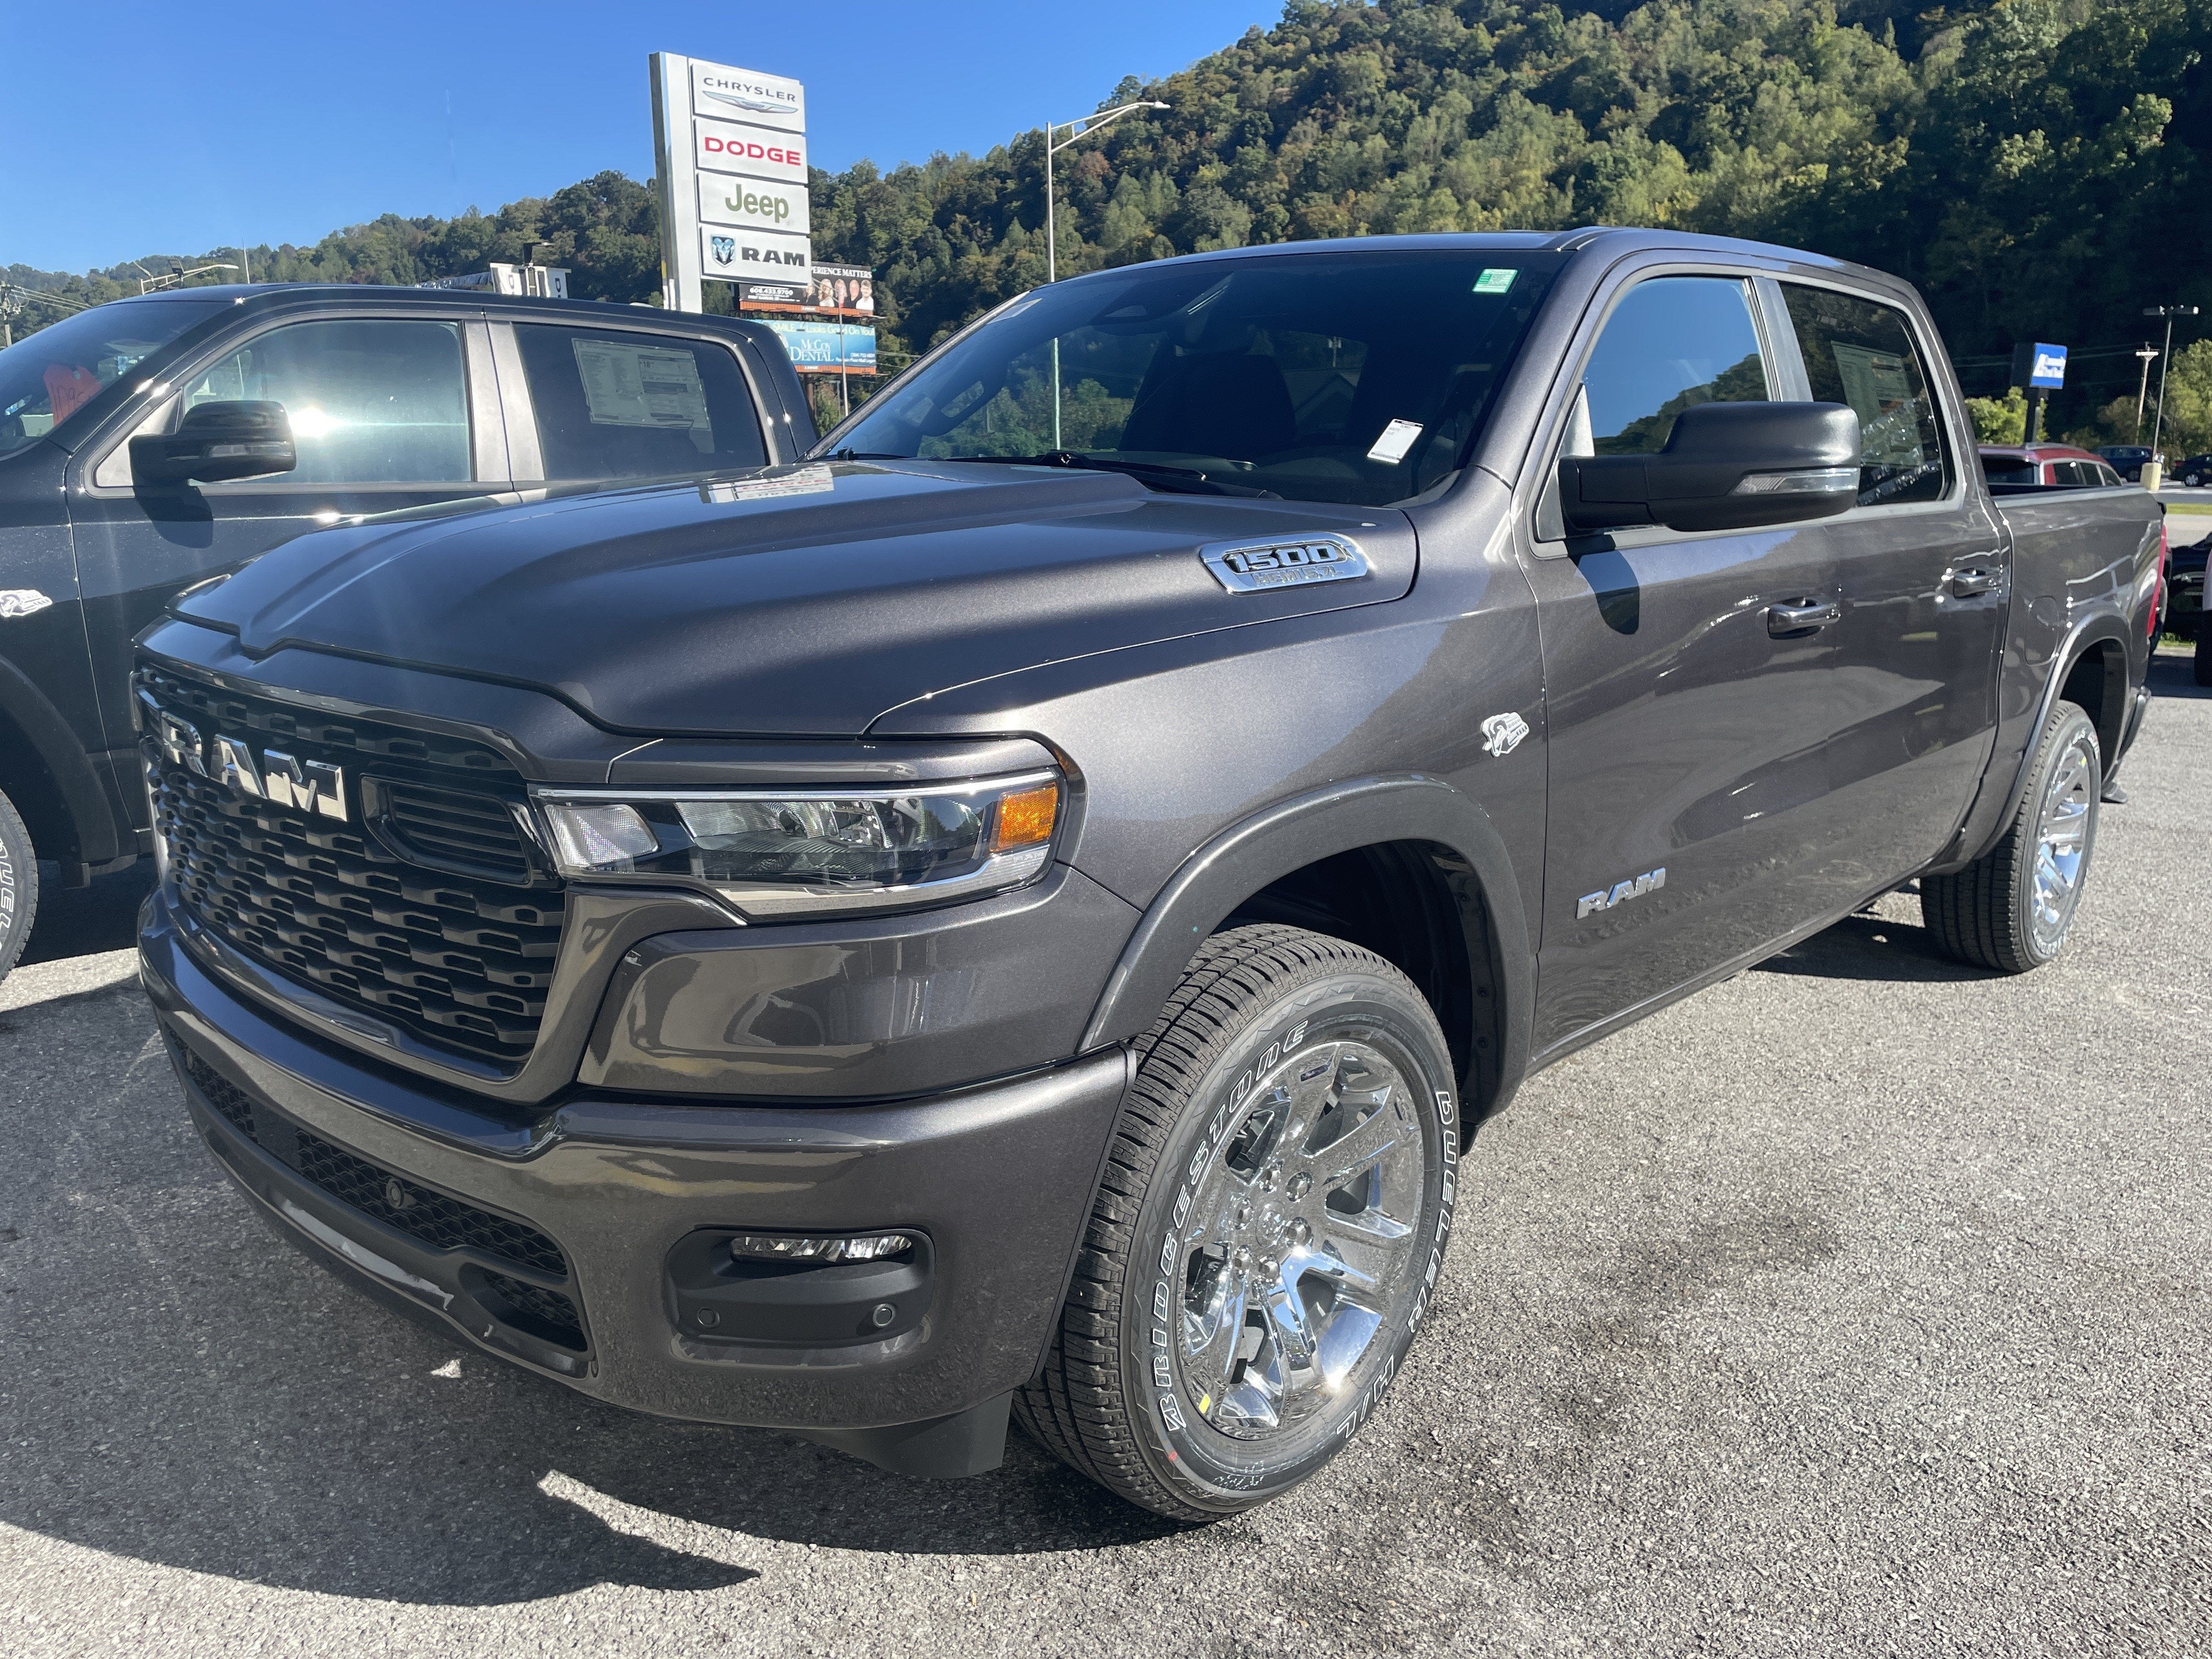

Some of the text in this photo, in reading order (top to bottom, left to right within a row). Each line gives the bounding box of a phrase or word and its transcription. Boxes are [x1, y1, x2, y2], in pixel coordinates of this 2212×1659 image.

[703, 77, 796, 102] CHRYSLER
[704, 137, 802, 166] DODGE
[725, 184, 789, 223] Jeep
[741, 246, 805, 267] RAM
[811, 266, 872, 278] ERIENCE MATTERS
[772, 323, 795, 332] SMILE
[790, 346, 834, 362] DENTAL
[1228, 544, 1338, 573] 1500
[1250, 565, 1344, 585] HEMI 5.7L
[161, 711, 348, 823] RAM
[1576, 867, 1666, 920] RAM
[1152, 1019, 1308, 1431] BRIDGESTONE
[1408, 1091, 1456, 1333] DUELER
